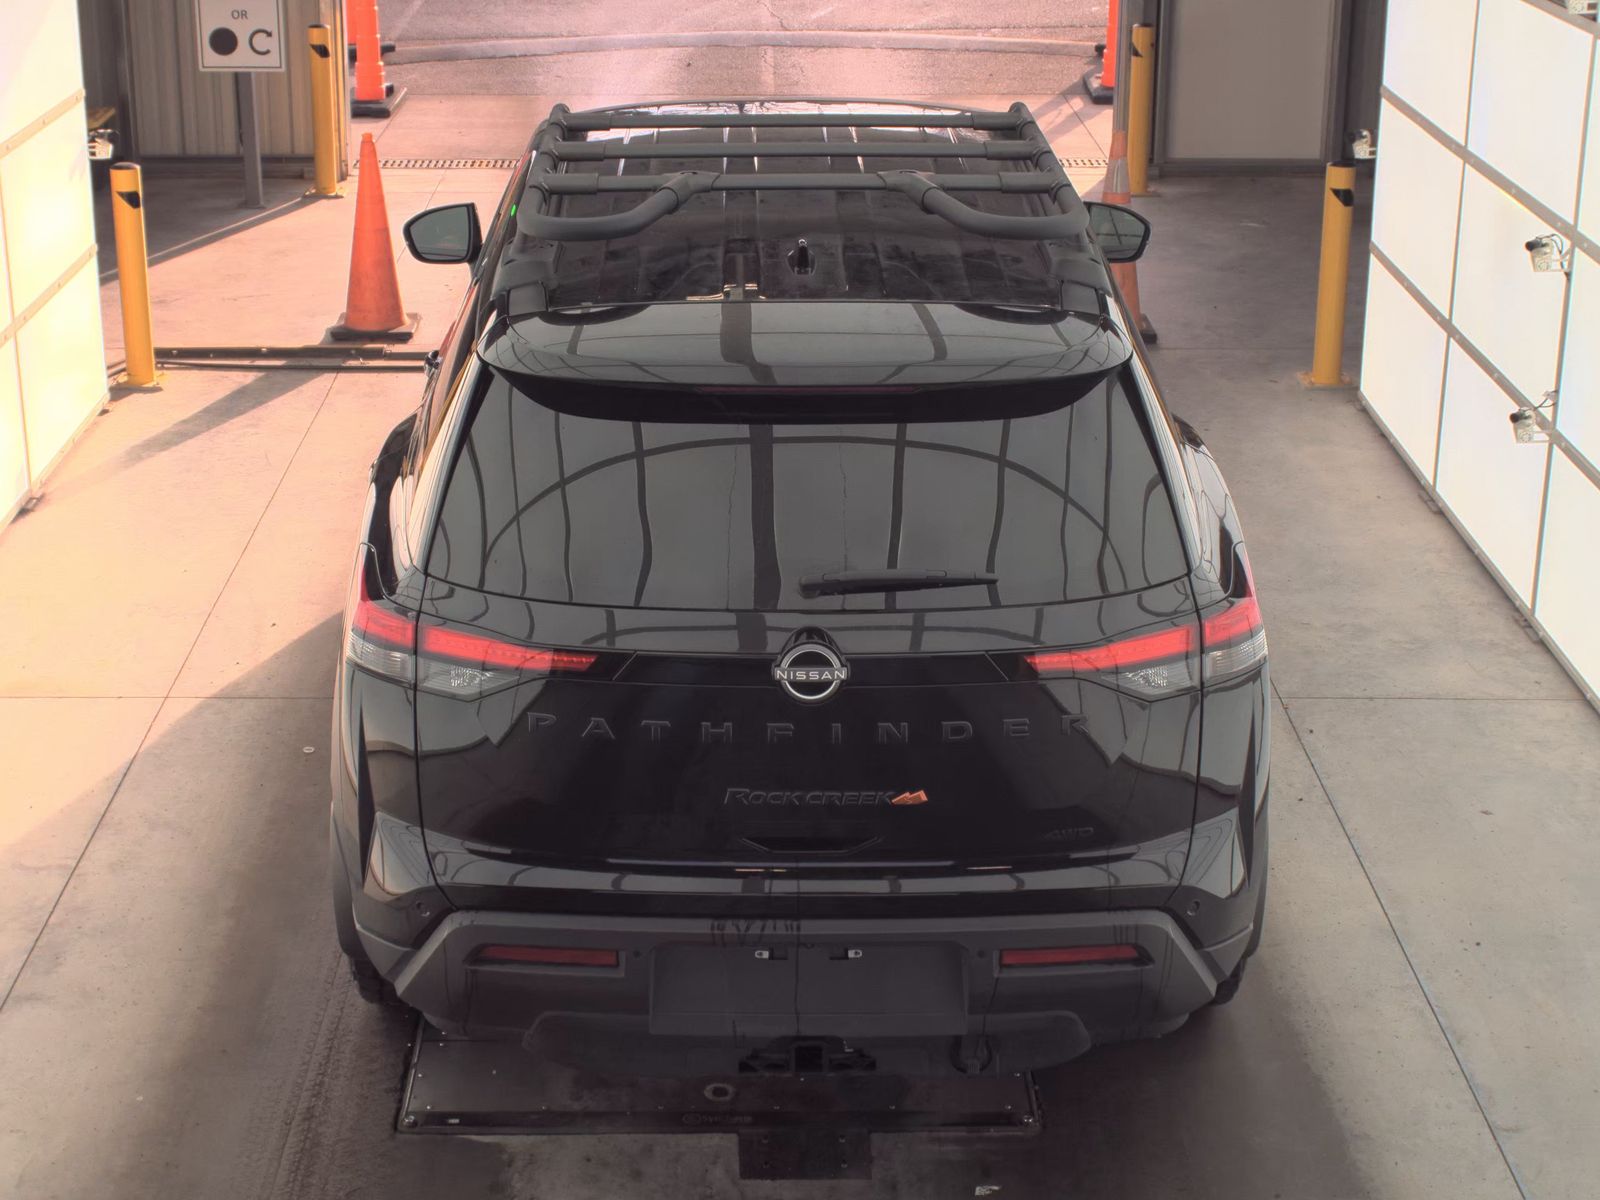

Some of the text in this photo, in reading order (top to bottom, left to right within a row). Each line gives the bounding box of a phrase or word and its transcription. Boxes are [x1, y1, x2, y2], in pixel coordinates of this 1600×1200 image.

[231, 9, 249, 20] OR
[776, 669, 845, 680] NISSAN
[526, 711, 1091, 744] PATHFINDER
[806, 791, 896, 805] CREEK
